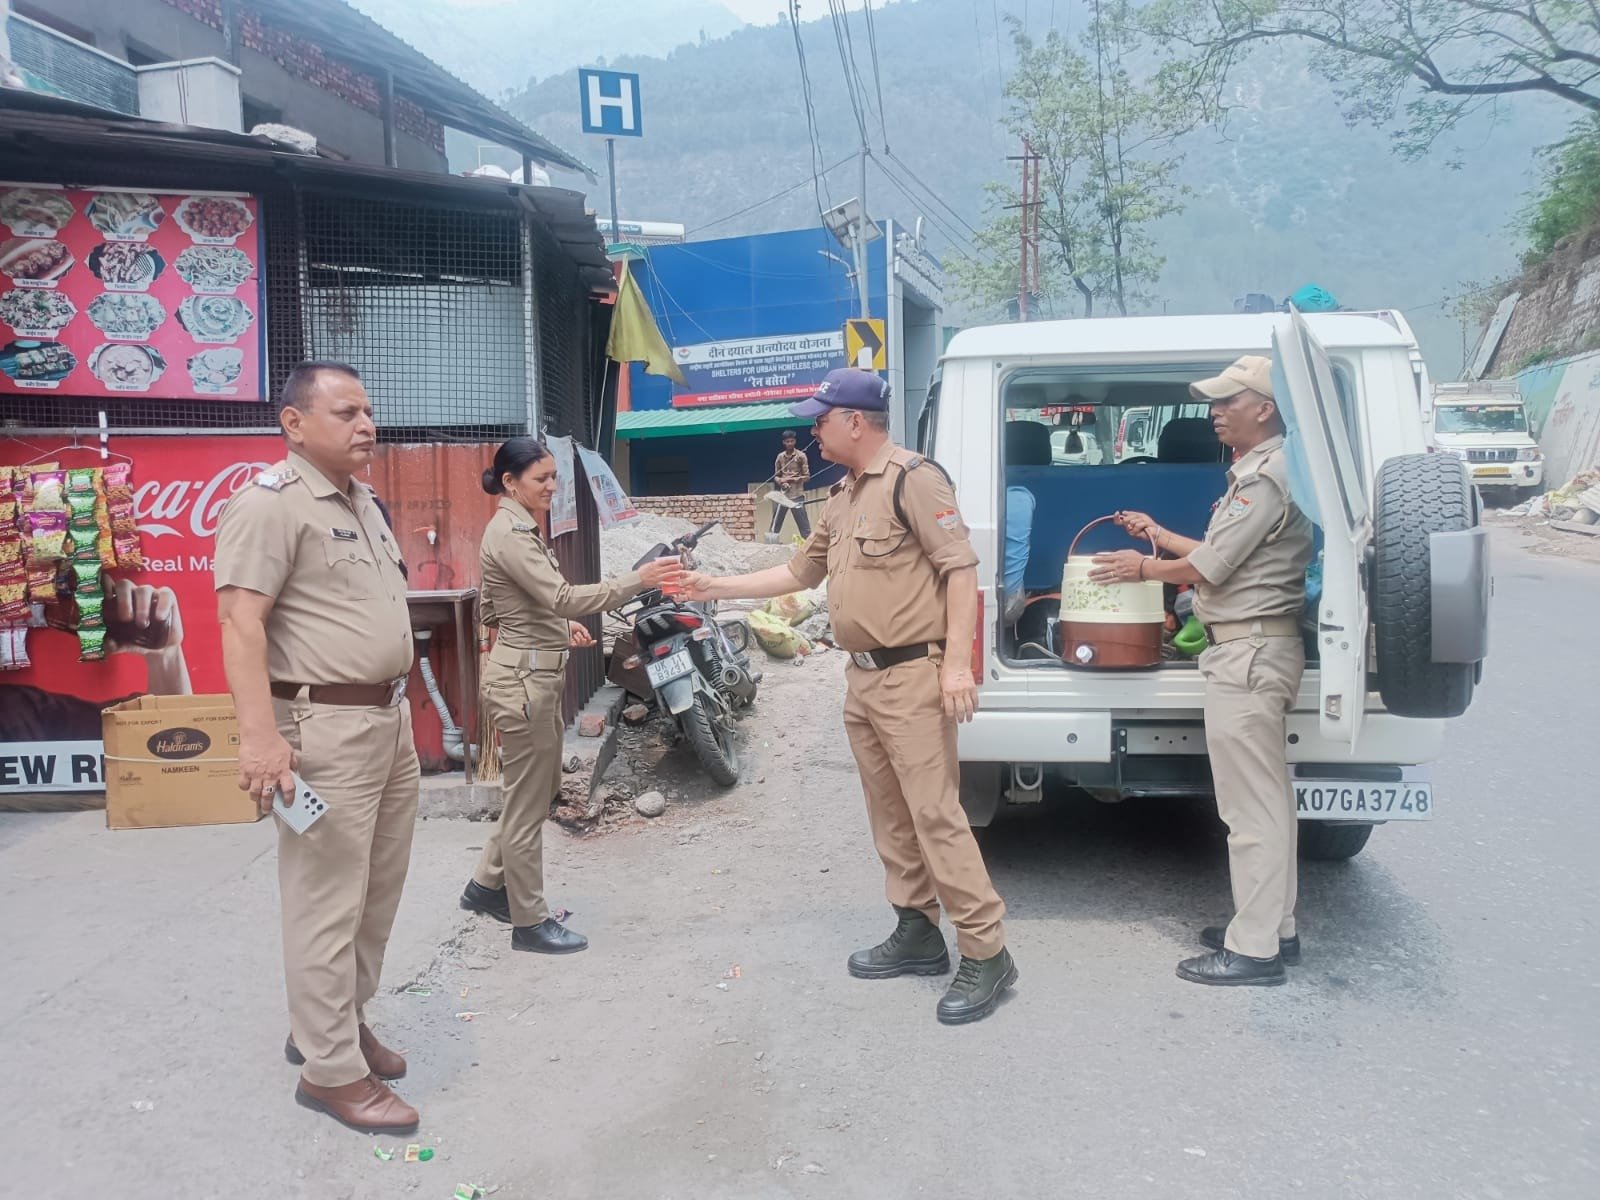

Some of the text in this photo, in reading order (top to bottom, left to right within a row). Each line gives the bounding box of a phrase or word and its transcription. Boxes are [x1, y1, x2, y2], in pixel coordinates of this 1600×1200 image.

[587, 75, 634, 130] H
[708, 346, 725, 358] दीन
[727, 345, 753, 357] दयाल
[799, 338, 832, 350] योजना
[711, 368, 742, 378] SHELTERS
[742, 366, 756, 375] FOR
[756, 364, 777, 374] URBAN
[778, 361, 811, 371] HOMELESS
[138, 555, 183, 572] Real
[161, 765, 200, 775] NAMKEEN
[1296, 788, 1429, 812] K07GA3748
